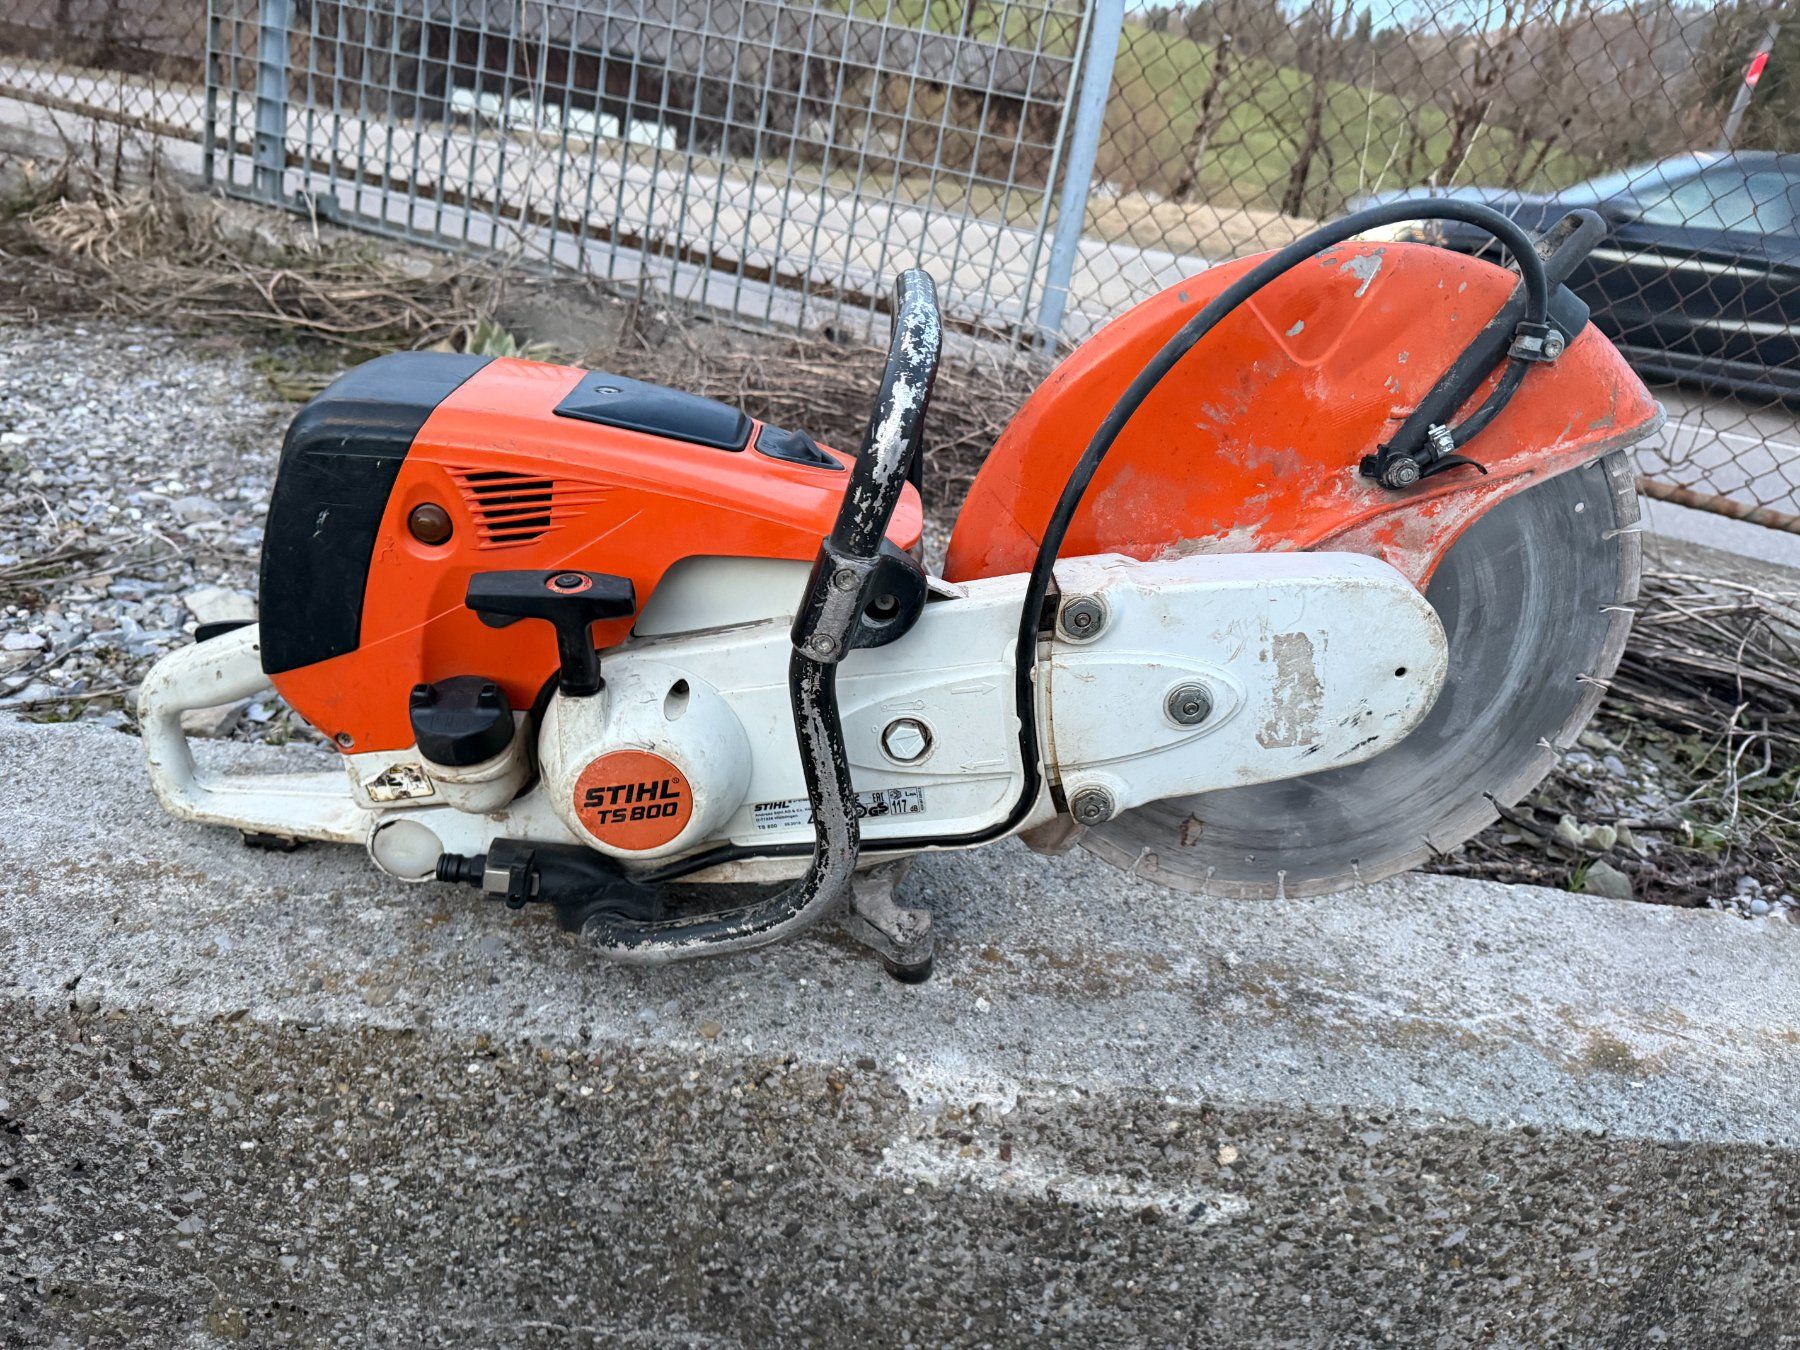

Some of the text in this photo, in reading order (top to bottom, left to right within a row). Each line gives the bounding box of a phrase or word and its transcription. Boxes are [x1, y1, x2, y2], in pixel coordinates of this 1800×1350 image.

[597, 802, 678, 824] TS 800
[754, 801, 790, 812] STIHL
[892, 799, 907, 813] 117
